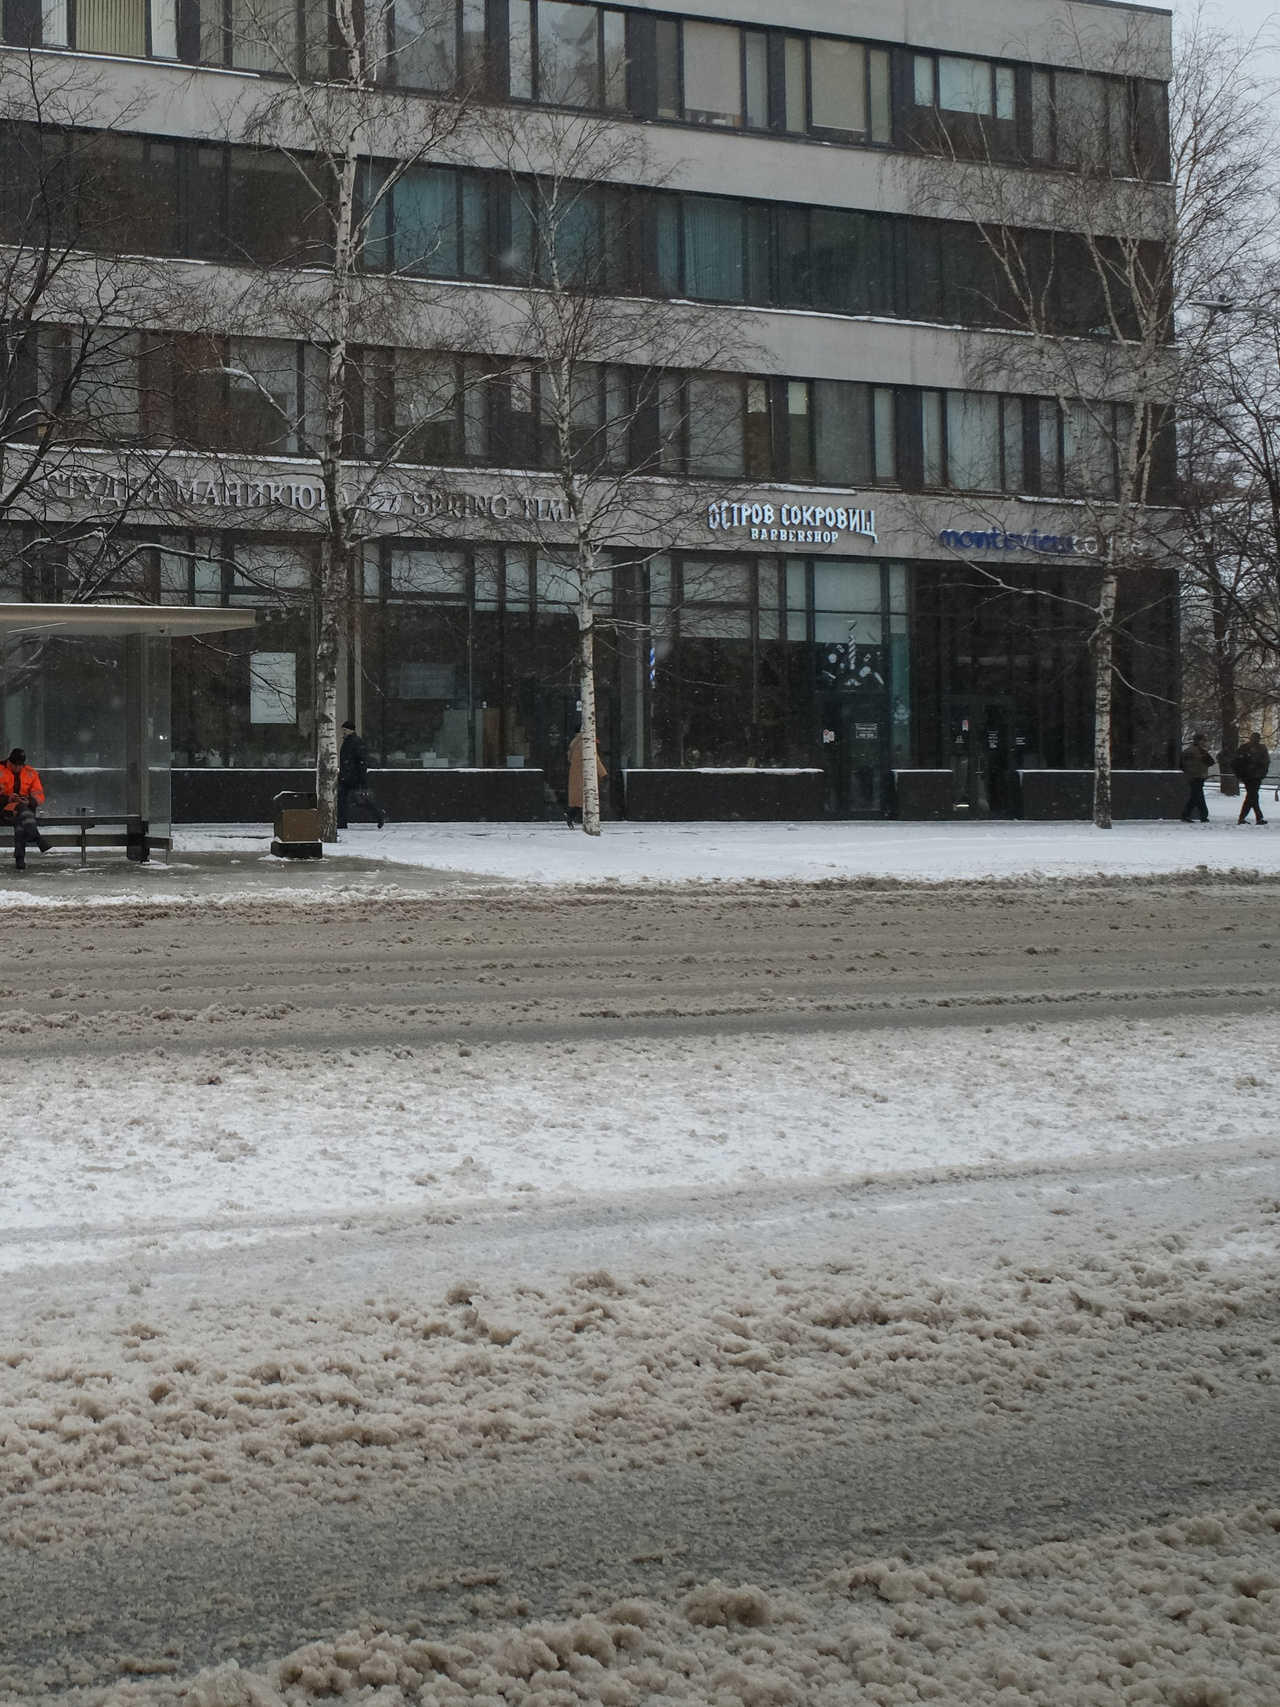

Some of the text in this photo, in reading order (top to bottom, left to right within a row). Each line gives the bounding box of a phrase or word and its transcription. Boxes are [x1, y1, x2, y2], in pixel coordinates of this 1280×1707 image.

[413, 492, 577, 522] SPRING TIM
[707, 500, 878, 544] ОСТРОВ СОКРОВИЩ
[751, 528, 839, 544] BARBERSHOP
